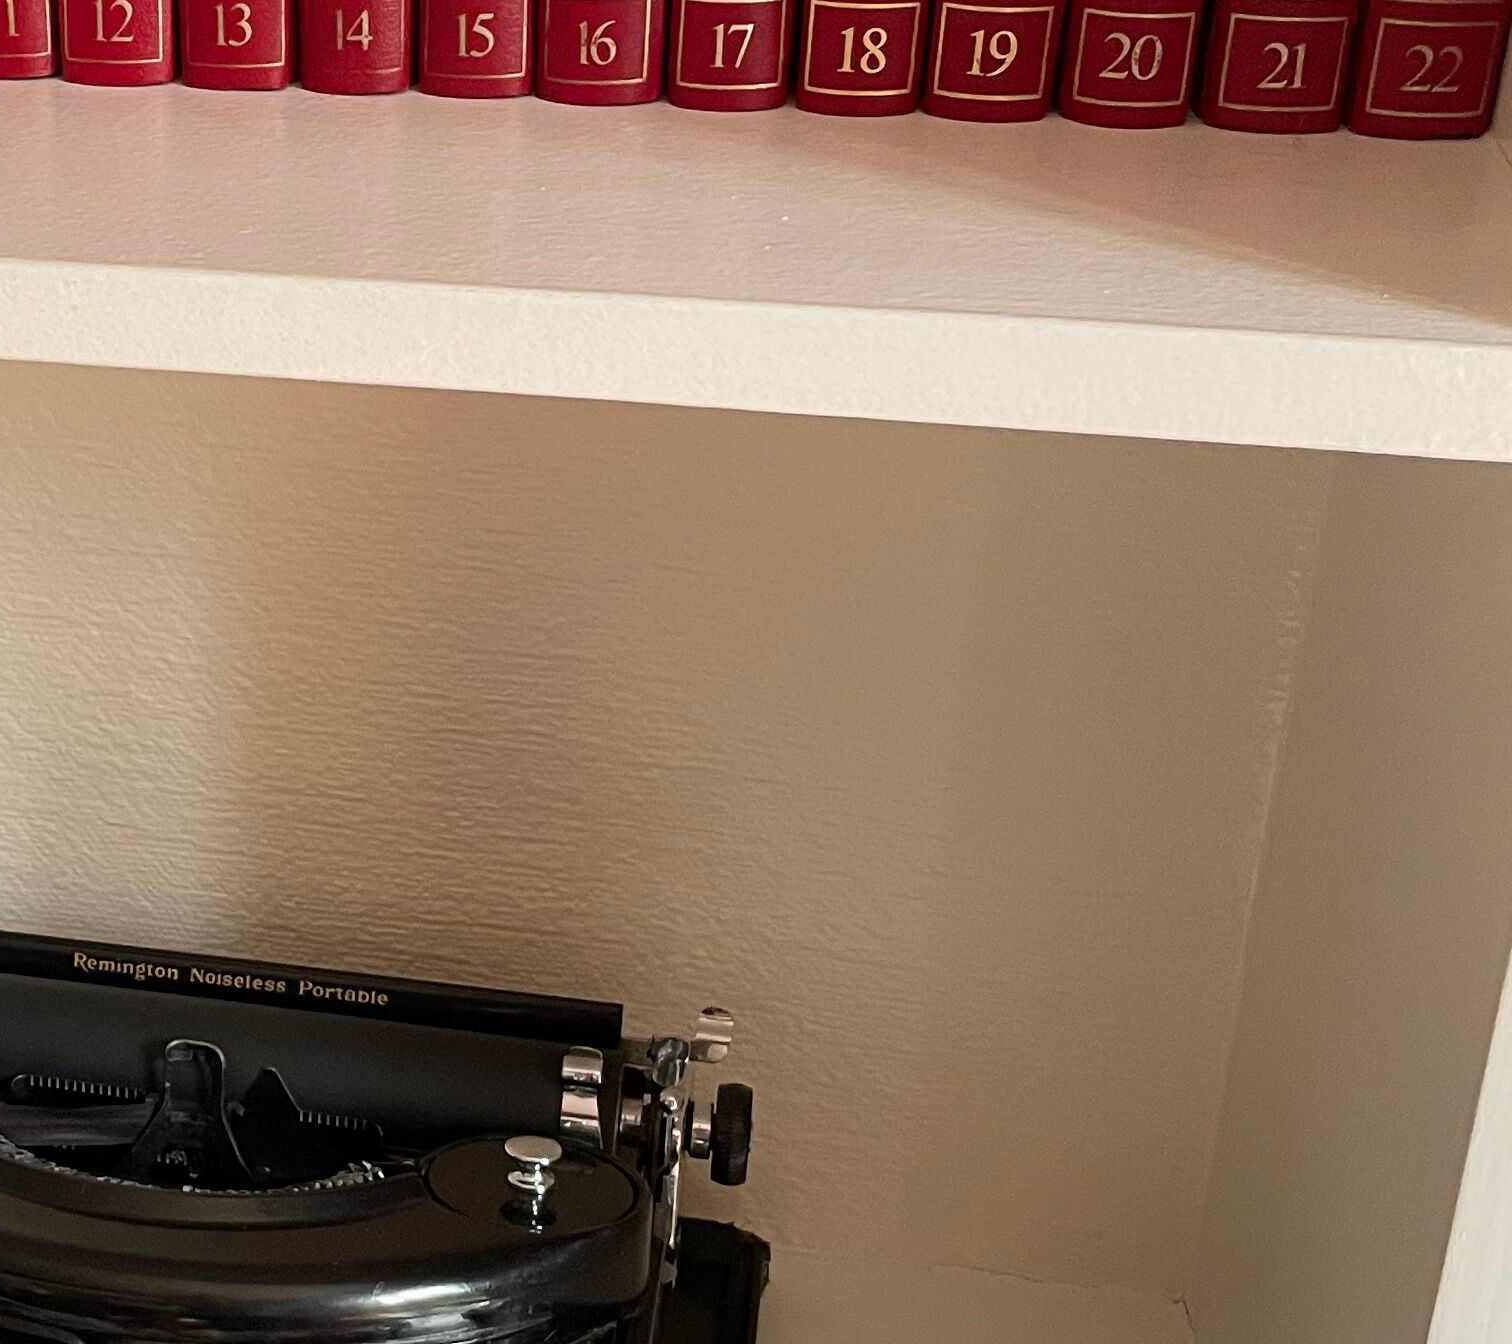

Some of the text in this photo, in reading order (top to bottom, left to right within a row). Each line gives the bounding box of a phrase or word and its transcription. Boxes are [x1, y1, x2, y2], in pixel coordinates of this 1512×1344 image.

[93, 0, 134, 42] 12
[215, 2, 254, 47] 13
[334, 9, 374, 51] 14
[457, 12, 496, 58] 15
[578, 20, 617, 66] 16
[712, 23, 755, 69] 17
[837, 27, 888, 74] 18
[965, 29, 1018, 78] 19
[1098, 32, 1163, 81] 20
[1256, 42, 1308, 90] 21
[1399, 44, 1465, 93] 22
[74, 952, 389, 1006] Remington Noiseless Portable
